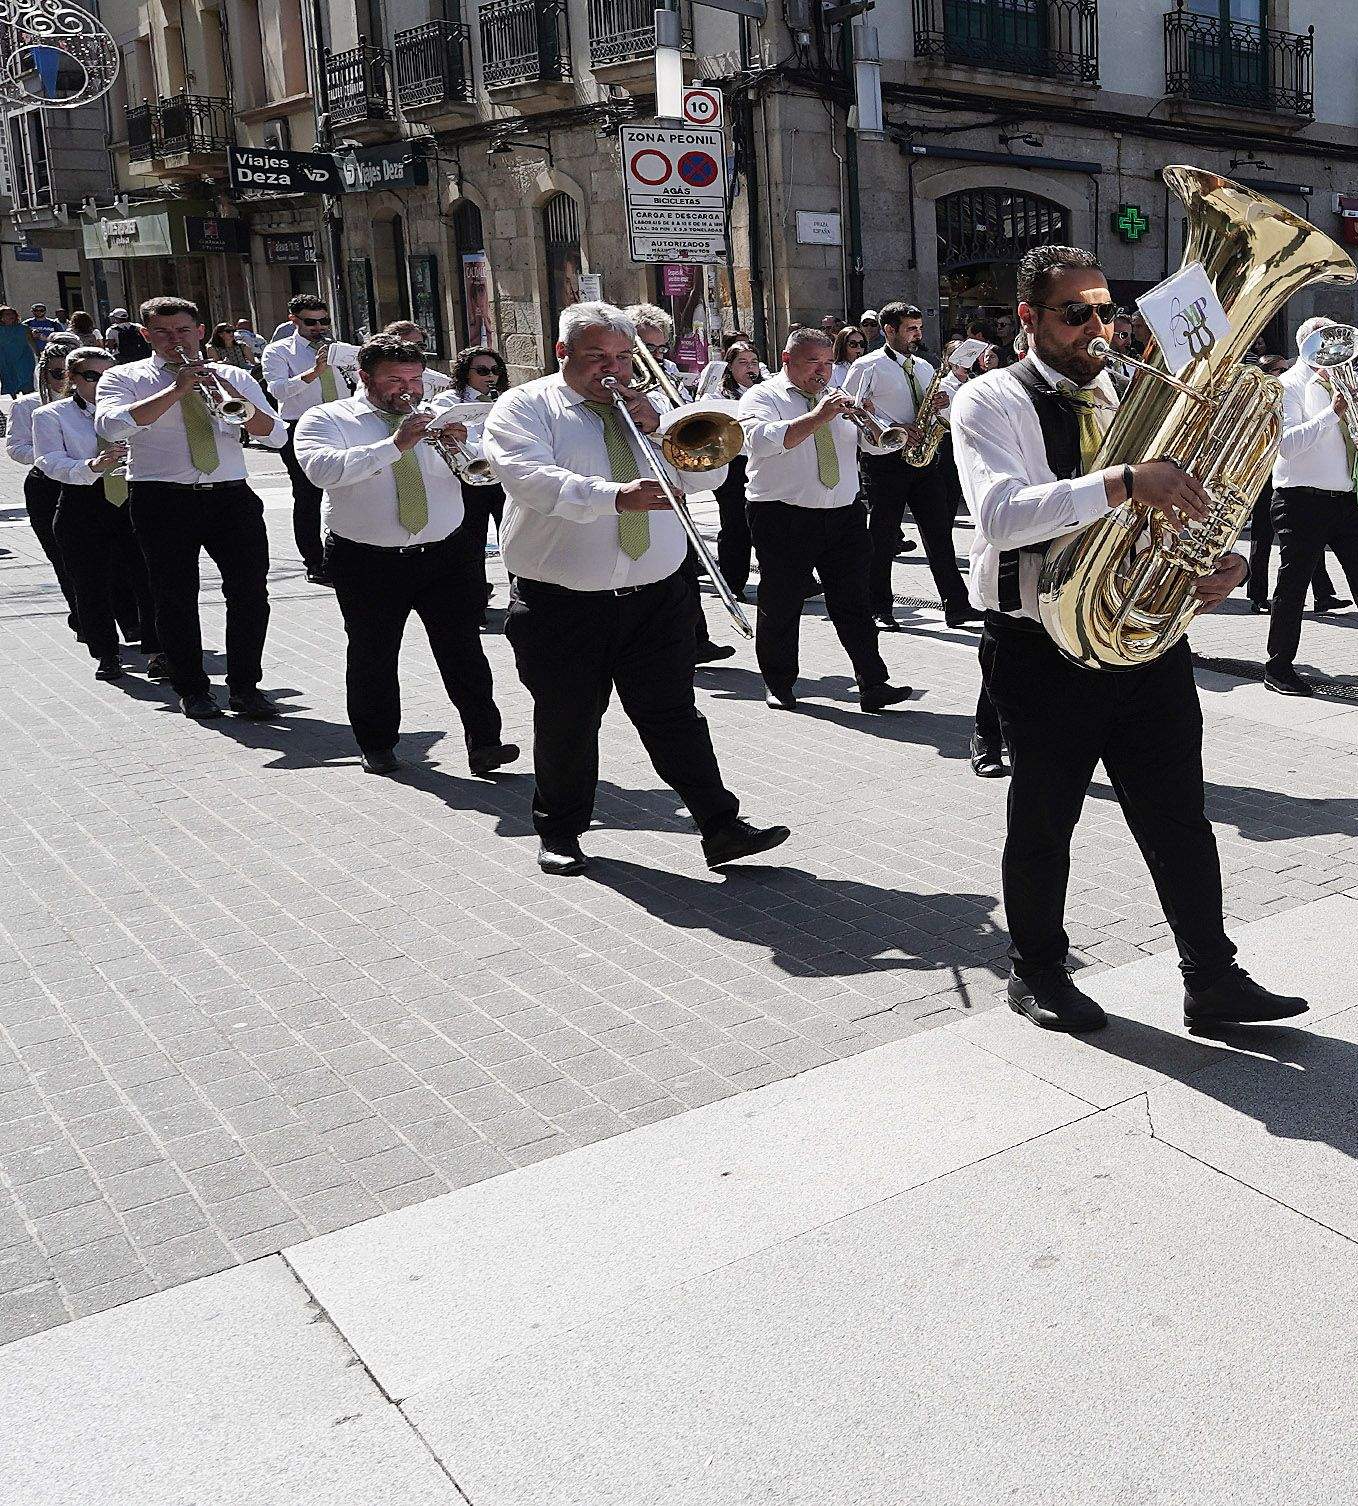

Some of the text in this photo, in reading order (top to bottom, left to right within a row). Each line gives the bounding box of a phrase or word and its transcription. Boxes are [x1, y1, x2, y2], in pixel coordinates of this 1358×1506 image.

[691, 102, 708, 113] 10
[628, 133, 716, 145] ZONA PEONIL
[235, 153, 290, 168] Viajes
[237, 168, 292, 185] Deza
[382, 159, 404, 182] Deza
[662, 186, 691, 195] AGÁS
